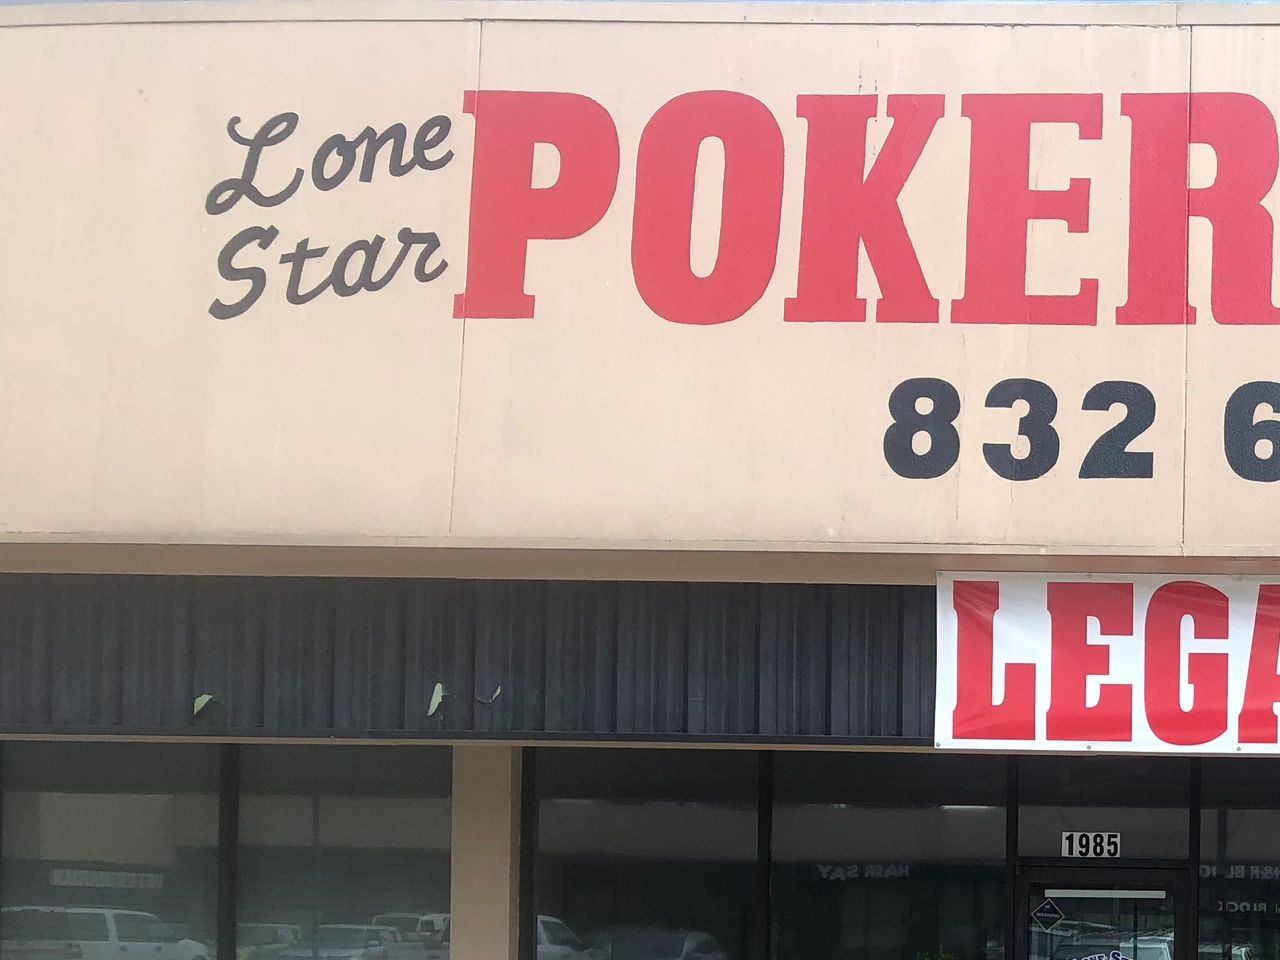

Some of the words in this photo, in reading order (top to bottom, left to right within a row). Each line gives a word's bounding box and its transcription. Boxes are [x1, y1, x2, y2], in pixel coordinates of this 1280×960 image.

[204, 110, 454, 216] Lone
[208, 225, 449, 320] Star
[883, 378, 1156, 482] 832
[1064, 832, 1119, 857] 1985
